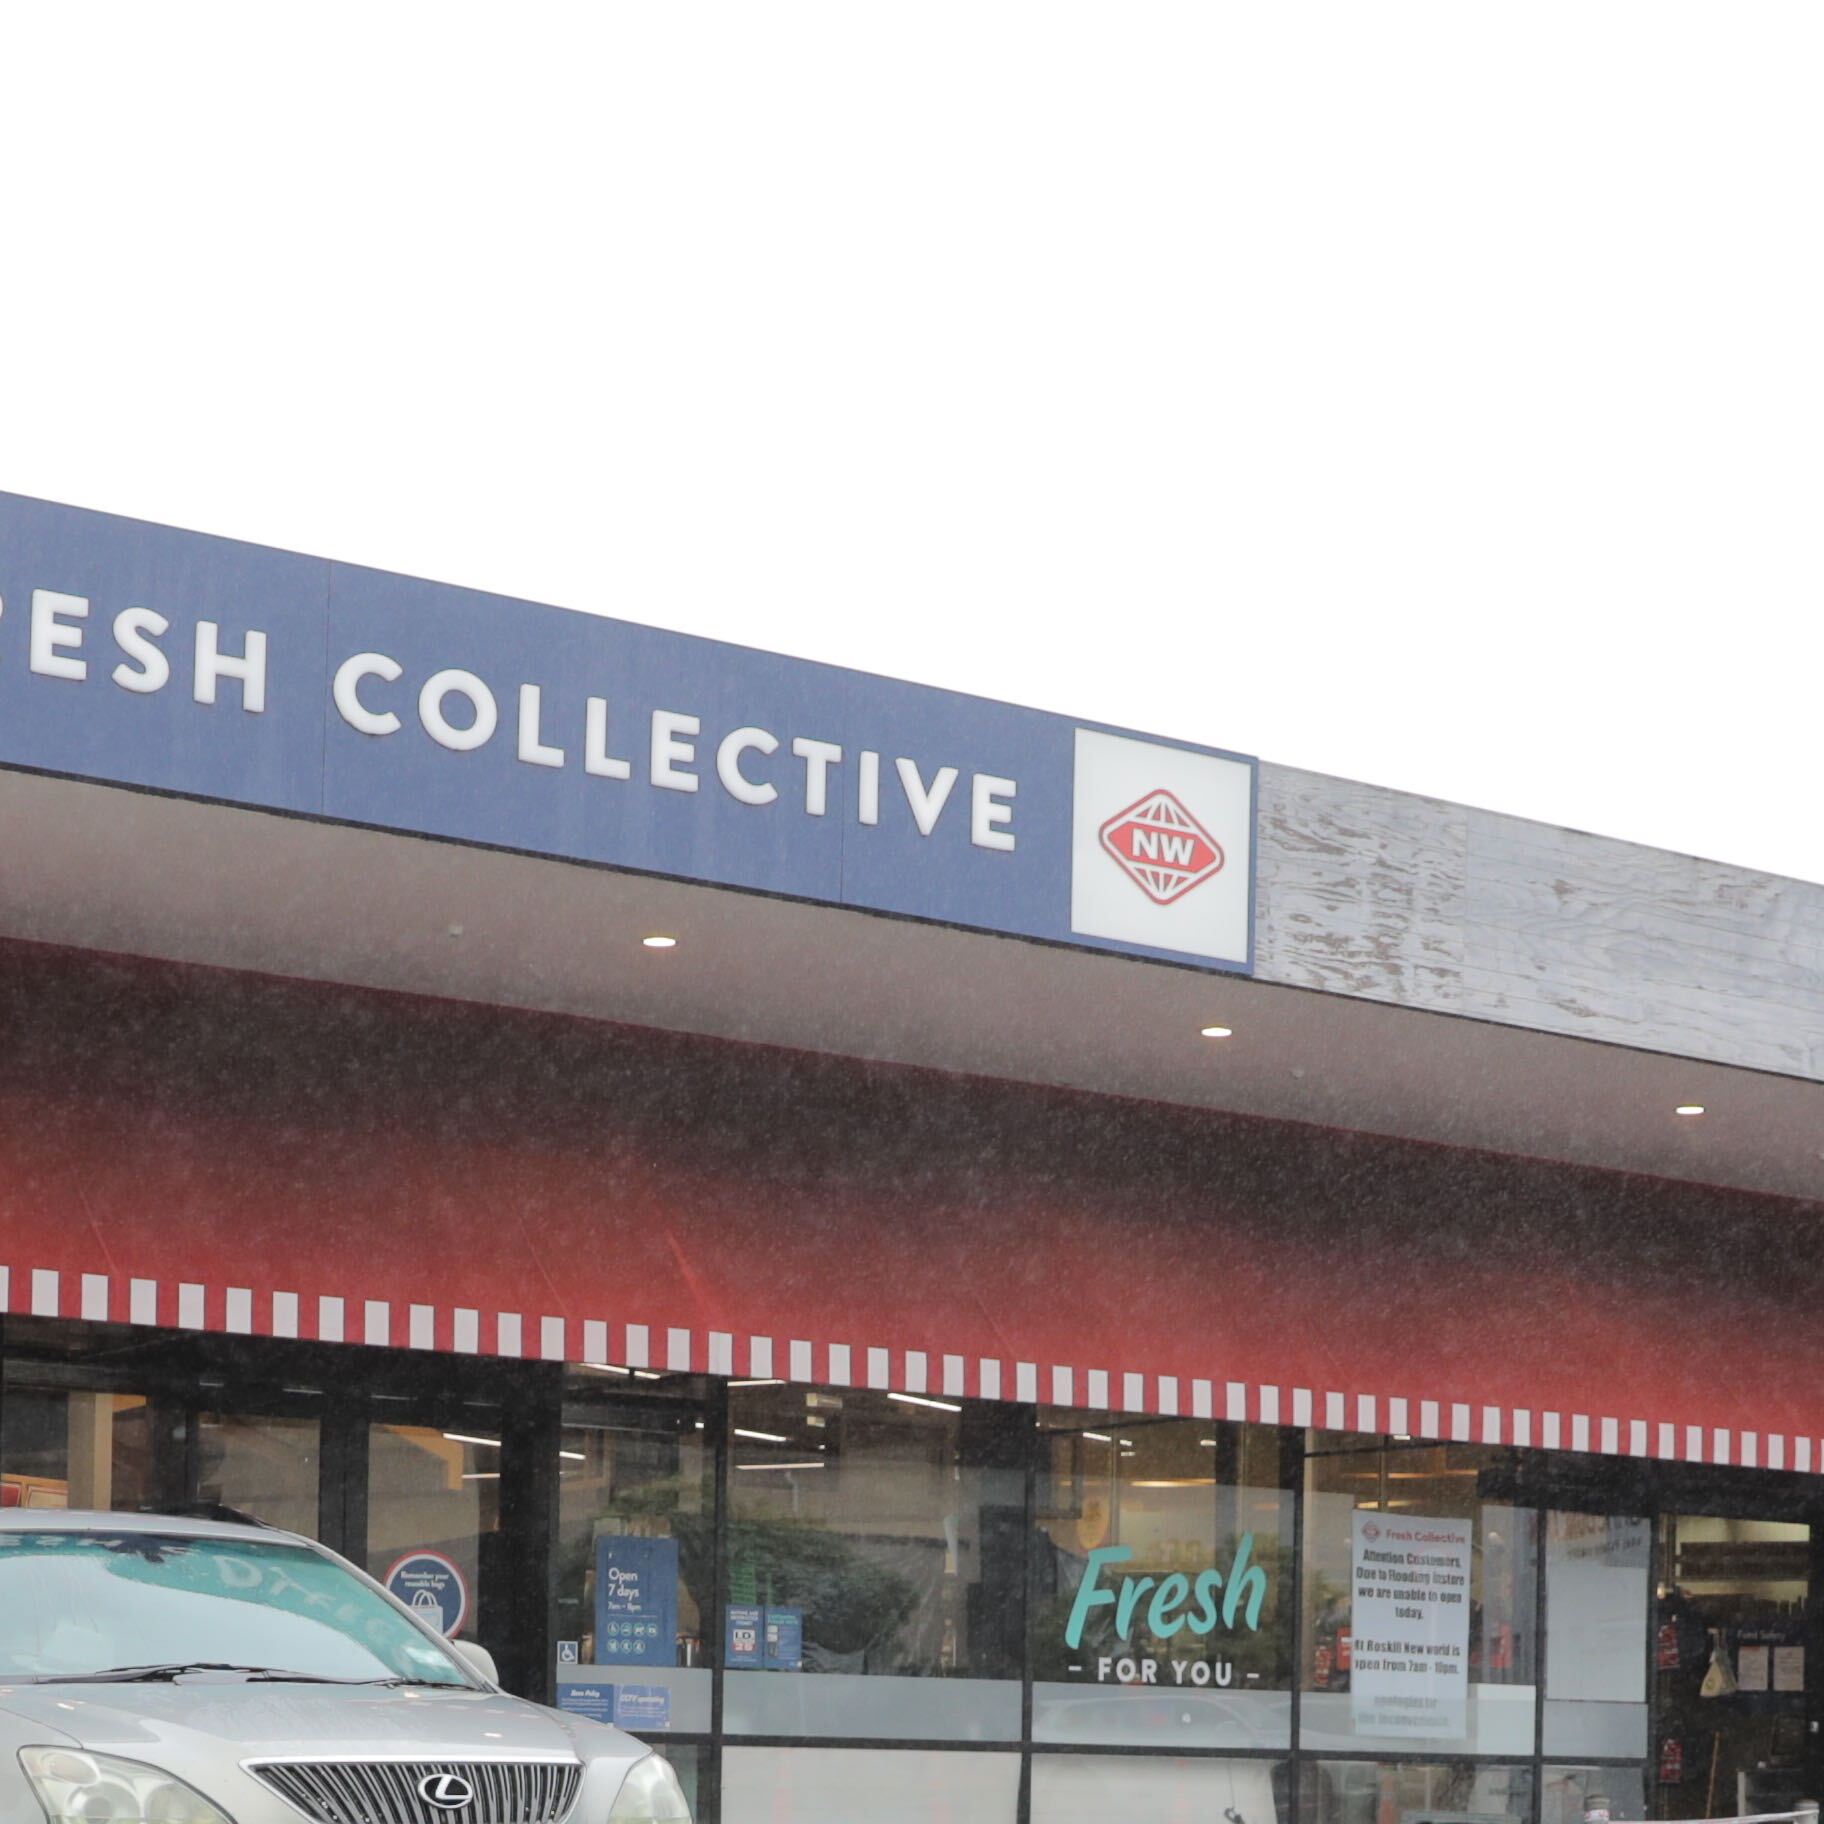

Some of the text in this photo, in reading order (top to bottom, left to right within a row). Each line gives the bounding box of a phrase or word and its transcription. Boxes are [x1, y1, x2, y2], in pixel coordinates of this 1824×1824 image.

[333, 652, 1017, 852] COLLECTIVE
[1131, 827, 1196, 867] NW
[1385, 1528, 1412, 1541] Fresh
[1414, 1531, 1466, 1544] Collective
[1362, 1548, 1404, 1565] Attention
[608, 1566, 638, 1585] Open
[1356, 1566, 1377, 1580] Due
[1378, 1568, 1387, 1581] to
[1388, 1569, 1430, 1585] Flooding
[608, 1583, 640, 1602] 7 days
[1064, 1531, 1267, 1650] Fresh
[1358, 1586, 1374, 1598] we
[1376, 1587, 1392, 1599] are
[1393, 1587, 1426, 1601] unable
[1440, 1591, 1462, 1604] open
[1366, 1639, 1402, 1654] Roskill
[1403, 1641, 1424, 1656] New
[1426, 1643, 1450, 1657] world
[1097, 1656, 1233, 1687] FOR YOU
[1383, 1659, 1407, 1672] from
